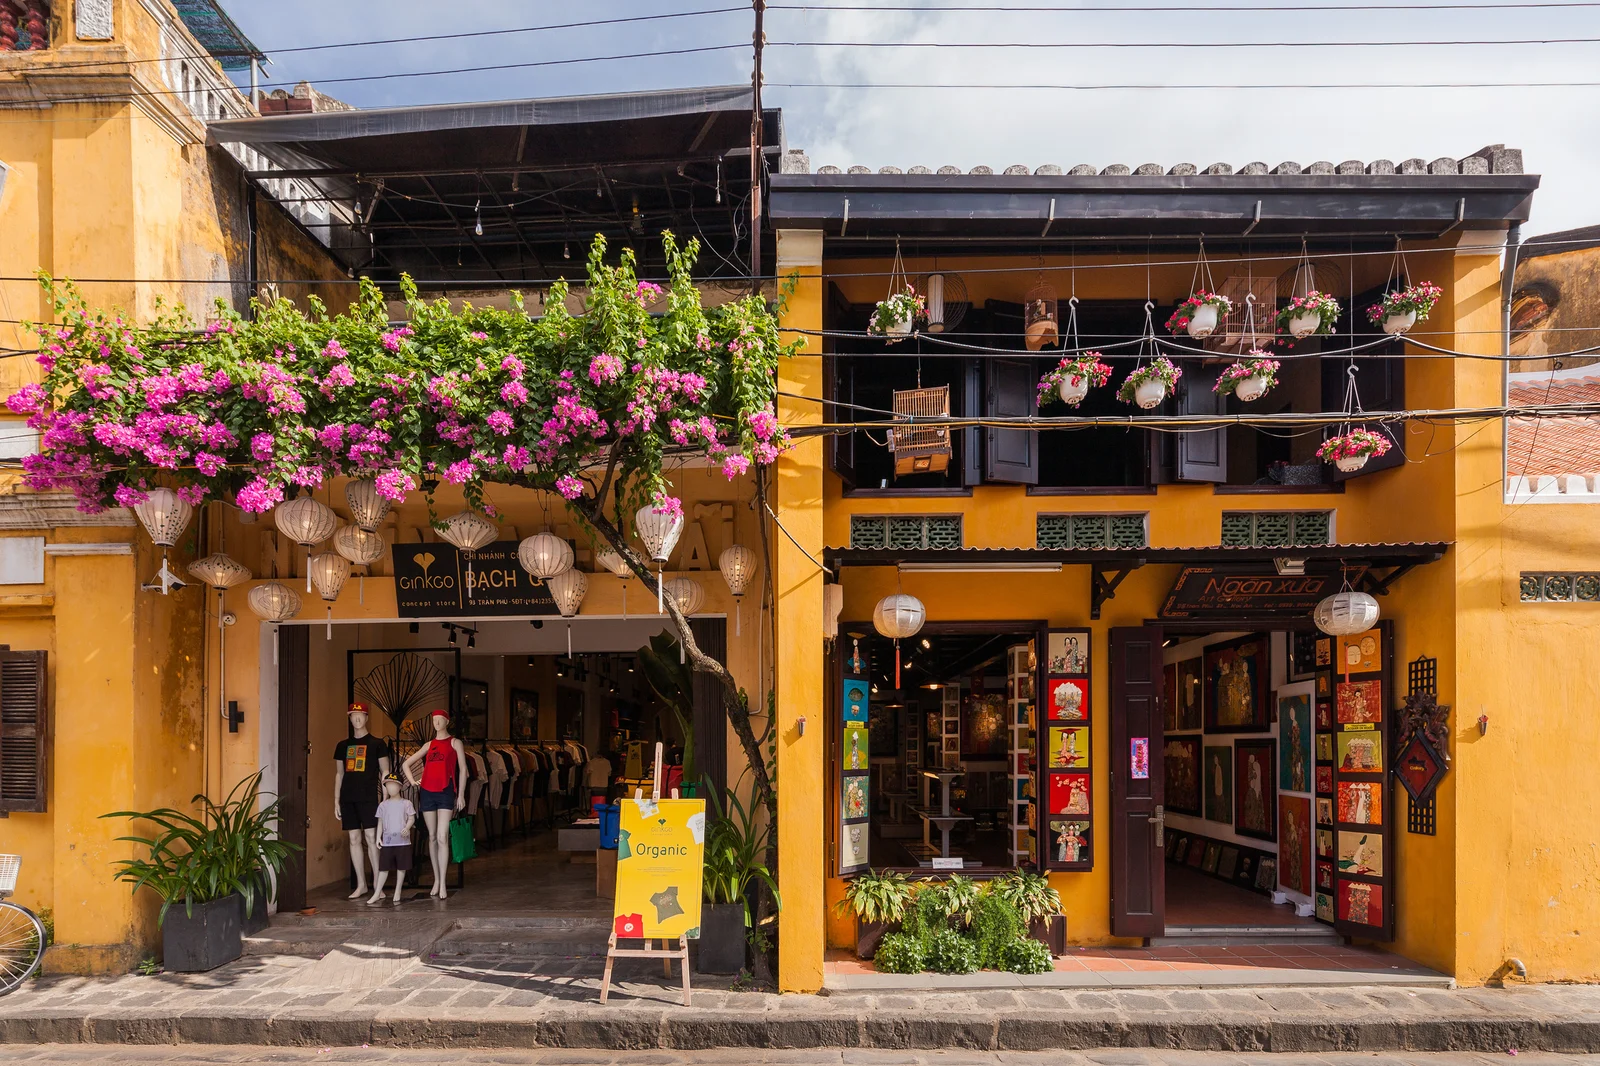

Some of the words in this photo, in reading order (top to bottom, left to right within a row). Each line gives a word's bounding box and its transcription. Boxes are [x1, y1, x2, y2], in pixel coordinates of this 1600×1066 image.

[464, 569, 517, 591] BẠCH
[401, 600, 432, 608] concept
[636, 843, 688, 858] Organic
